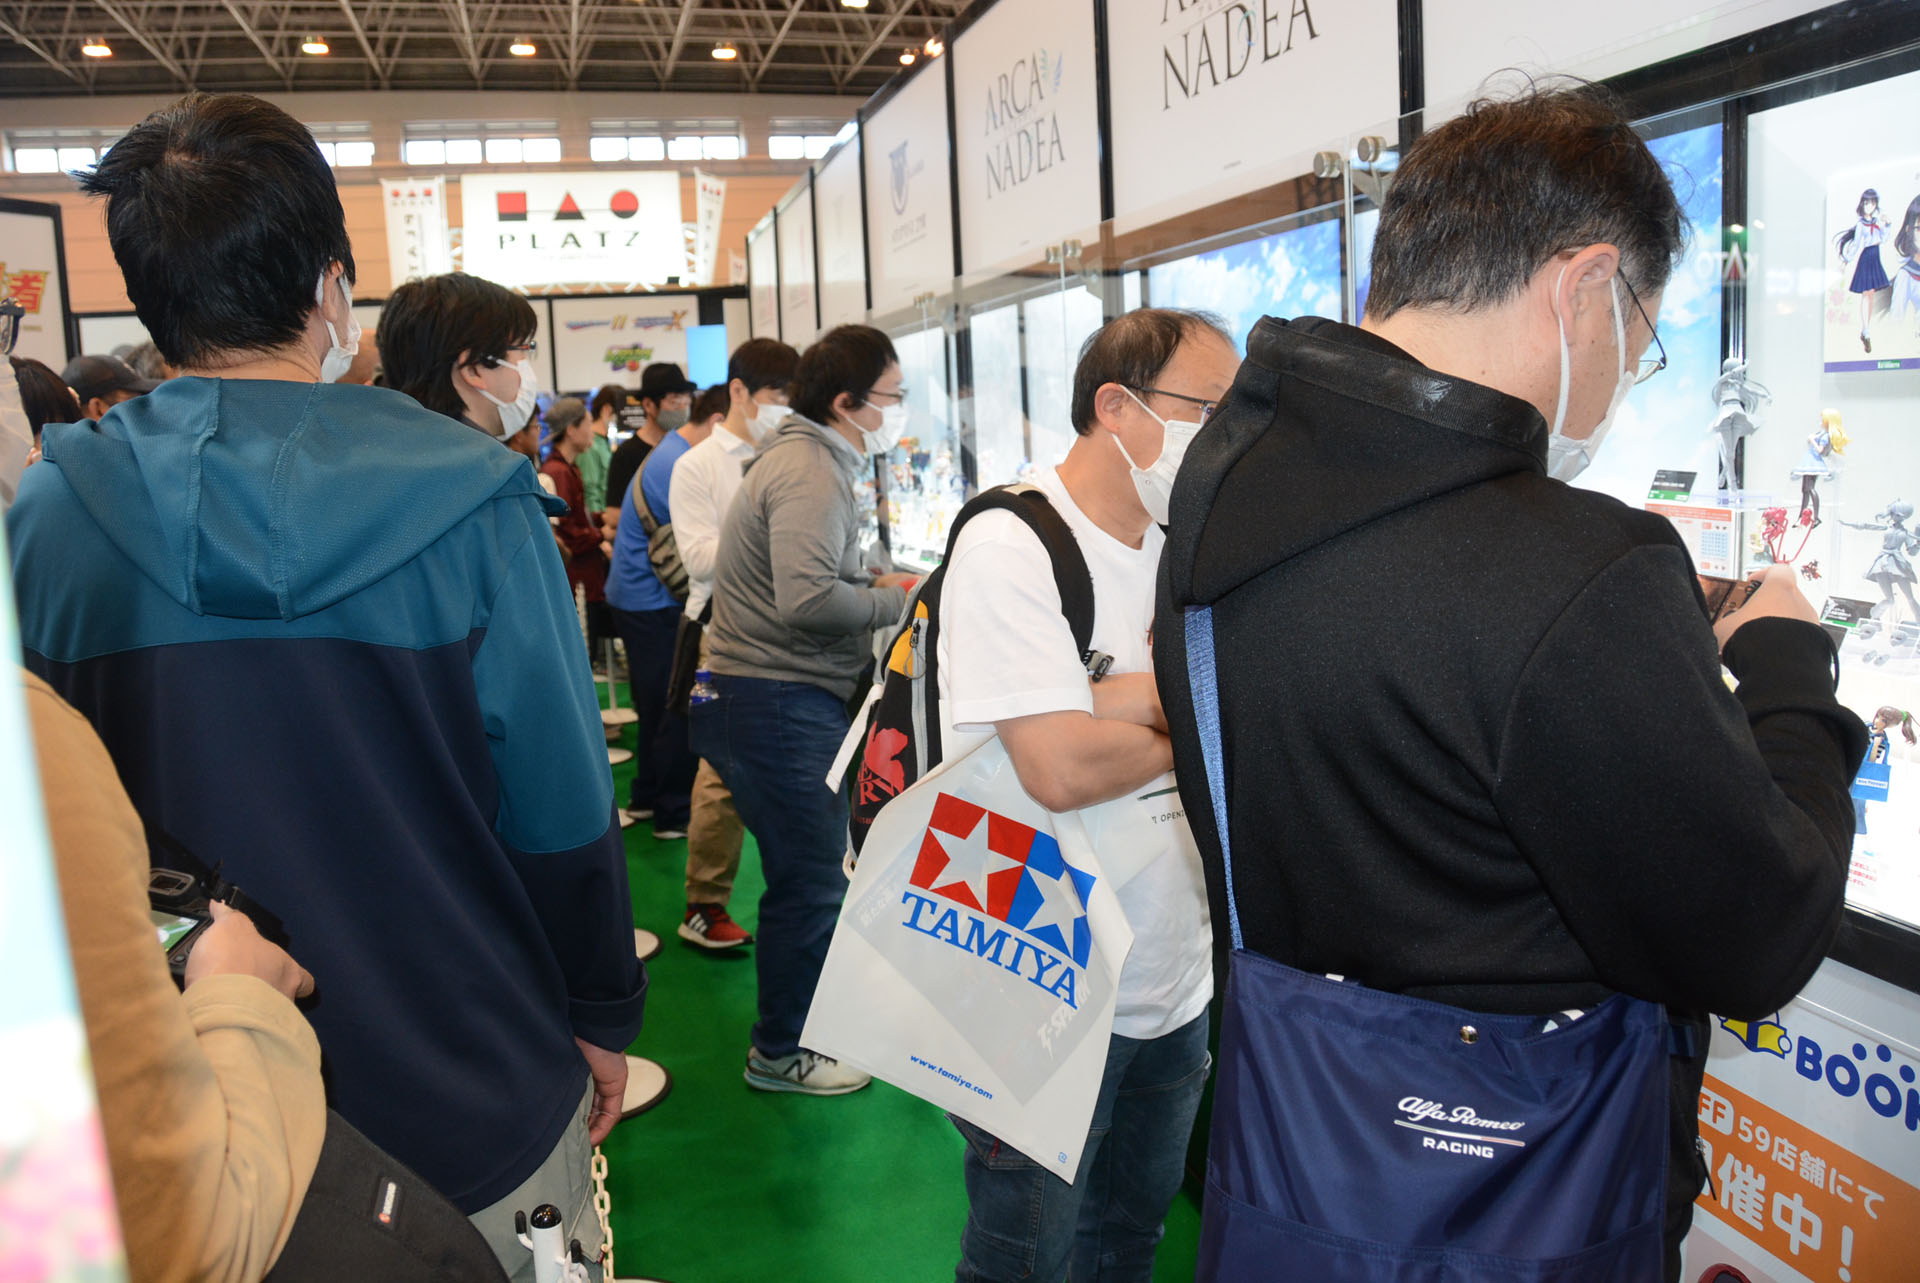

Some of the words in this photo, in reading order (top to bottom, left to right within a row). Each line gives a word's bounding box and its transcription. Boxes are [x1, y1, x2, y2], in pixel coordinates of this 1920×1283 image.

[985, 52, 1044, 136] ARCA
[1161, 0, 1320, 111] NADEA
[986, 112, 1066, 199] NADEA
[499, 231, 640, 250] PLATZ
[902, 891, 1078, 1010] TAMIYA
[910, 1055, 993, 1100] www.tamiya.com
[1398, 1096, 1448, 1121] Alfa
[1448, 1106, 1526, 1130] Romeo
[1422, 1136, 1494, 1159] RACING
[1697, 1136, 1854, 1283] 催中！
